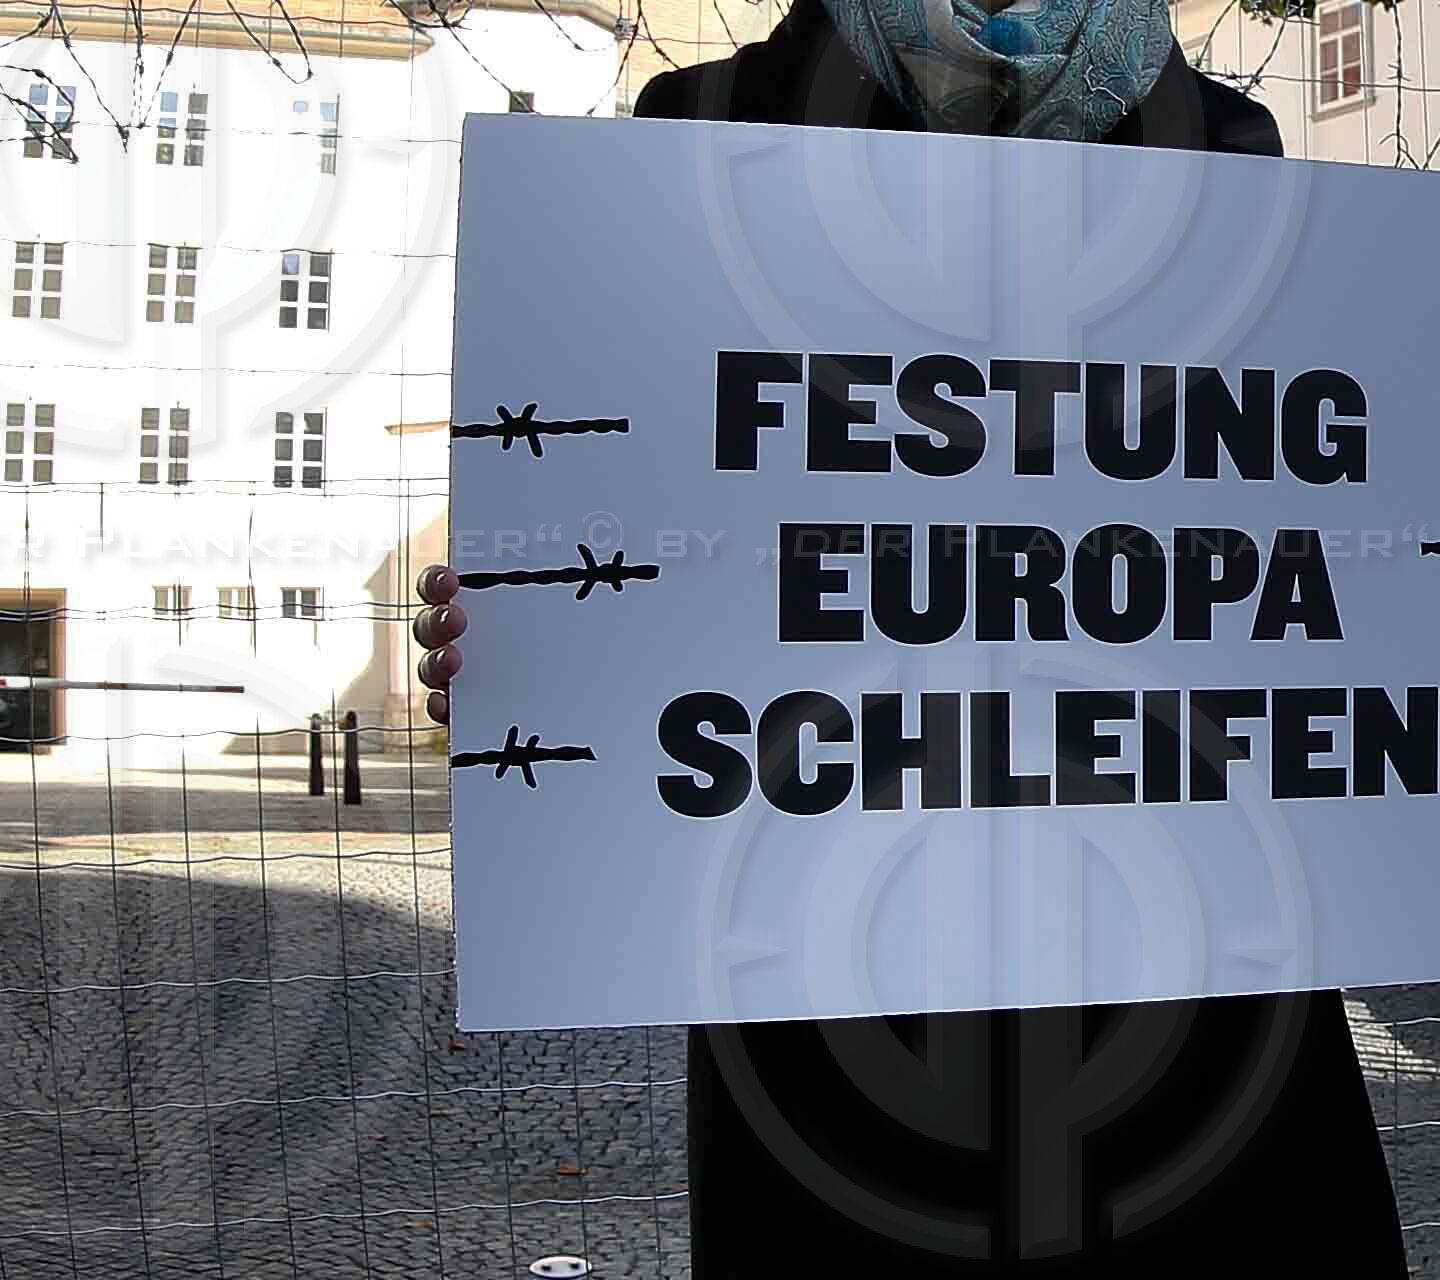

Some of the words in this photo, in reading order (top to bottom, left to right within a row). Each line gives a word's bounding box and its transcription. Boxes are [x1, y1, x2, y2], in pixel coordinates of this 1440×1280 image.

[715, 350, 1369, 485] FESTUNG
[777, 521, 1346, 645] EUROPA
[656, 685, 1440, 818] SCHLEIFEN
